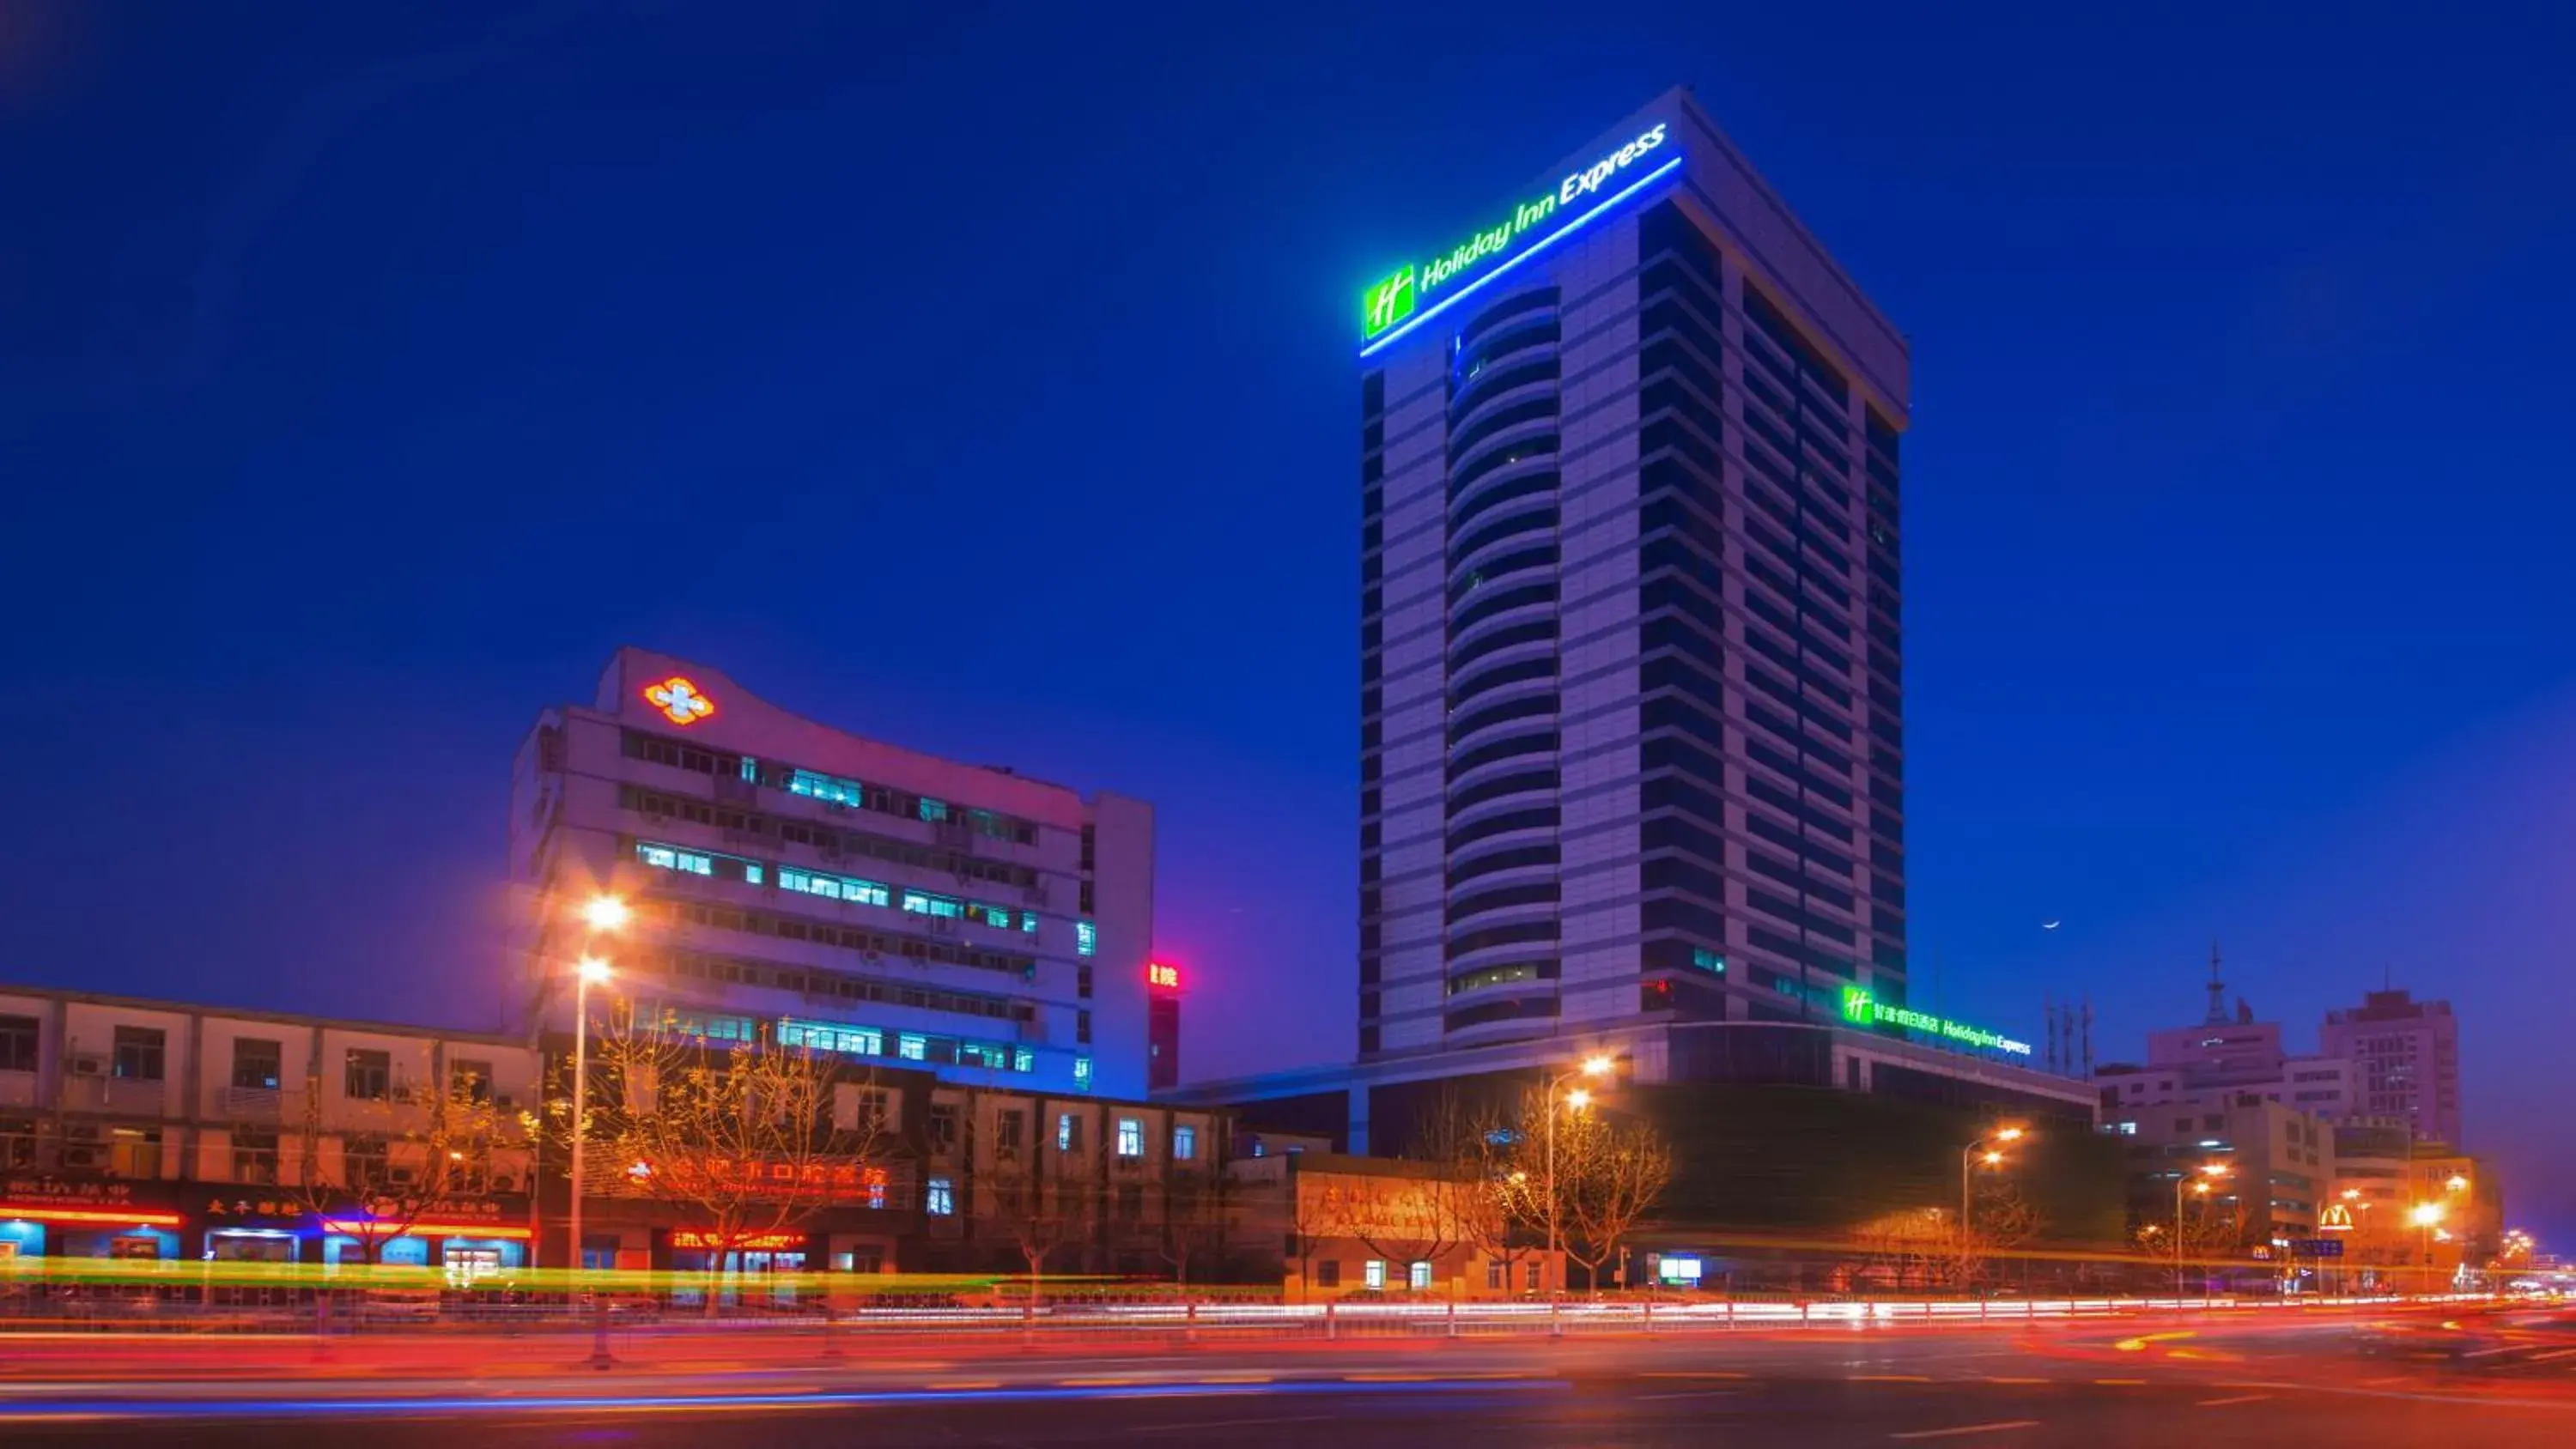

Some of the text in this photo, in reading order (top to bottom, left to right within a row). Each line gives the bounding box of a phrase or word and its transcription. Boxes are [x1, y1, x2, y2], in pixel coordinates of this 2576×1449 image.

[1420, 220, 1511, 293] Holiday
[1514, 191, 1555, 233] Inn
[1559, 122, 1668, 205] Express
[1943, 1019, 1981, 1046] Holiday
[1996, 1034, 2031, 1055] Express
